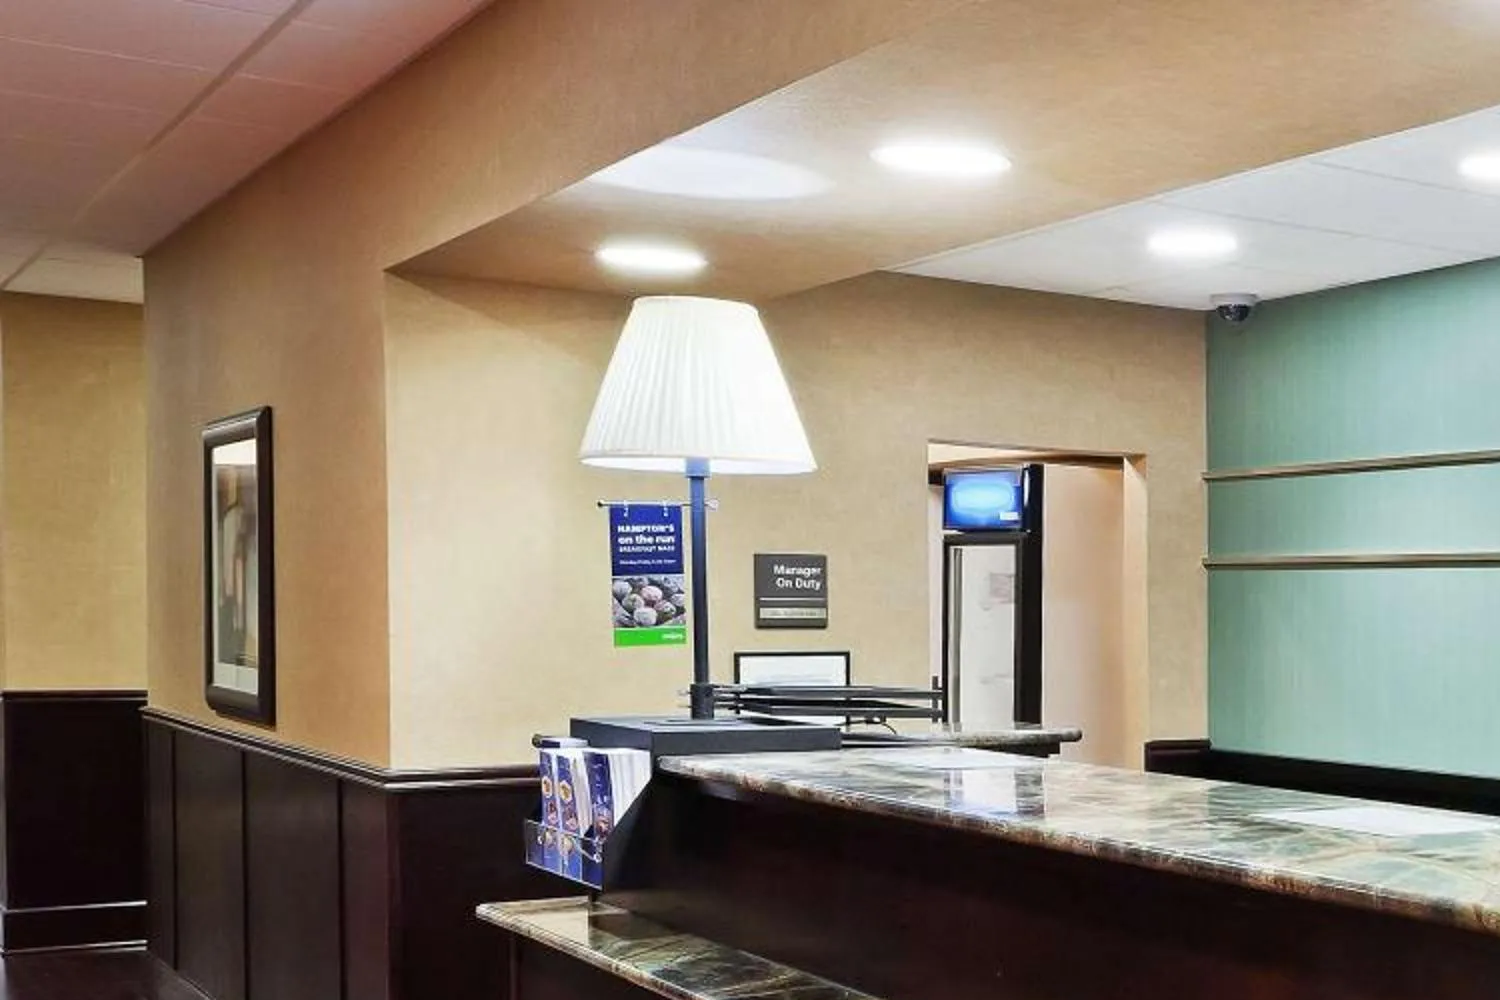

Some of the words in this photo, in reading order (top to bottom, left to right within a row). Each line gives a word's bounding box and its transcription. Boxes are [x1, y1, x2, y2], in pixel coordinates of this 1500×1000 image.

[617, 536, 633, 545] on
[635, 534, 654, 545] the
[655, 535, 675, 544] run
[773, 564, 821, 578] Manager
[776, 577, 793, 588] On
[795, 577, 821, 591] Duty
